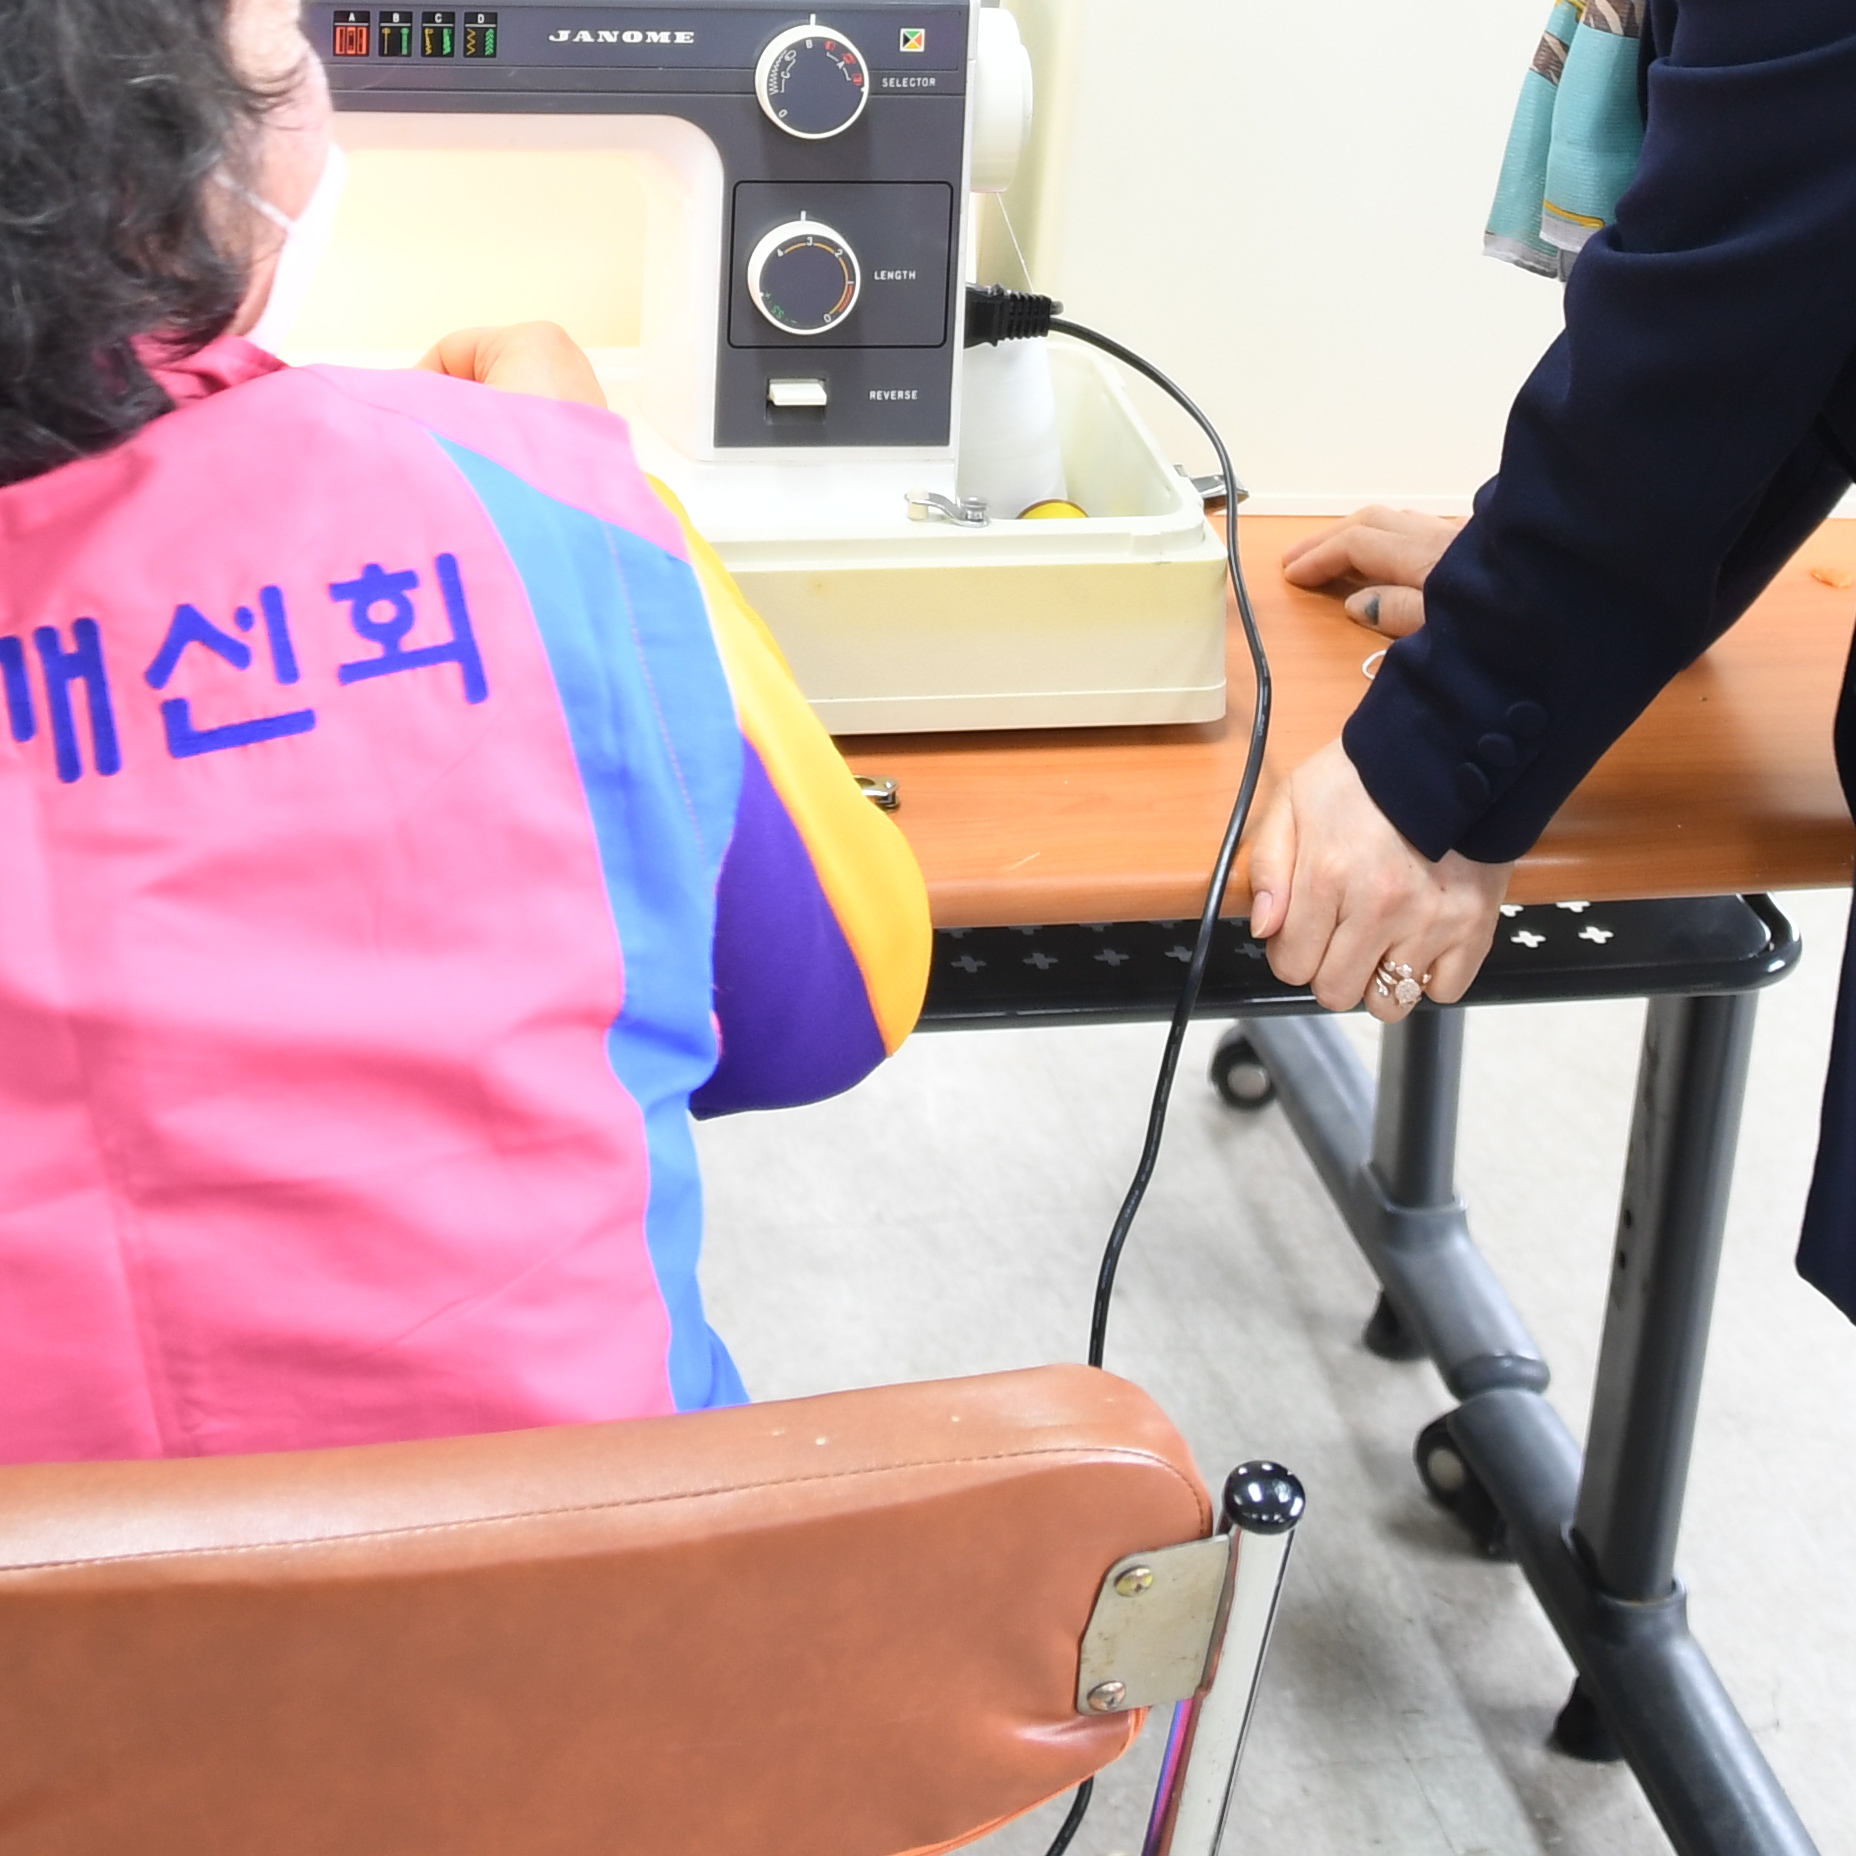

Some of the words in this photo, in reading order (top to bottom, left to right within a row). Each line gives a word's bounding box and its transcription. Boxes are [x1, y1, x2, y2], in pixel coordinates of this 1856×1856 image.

[547, 29, 695, 44] JANOME
[881, 76, 937, 88] SELECTOR
[873, 270, 917, 281] LENGTH
[869, 389, 919, 401] REVERSE
